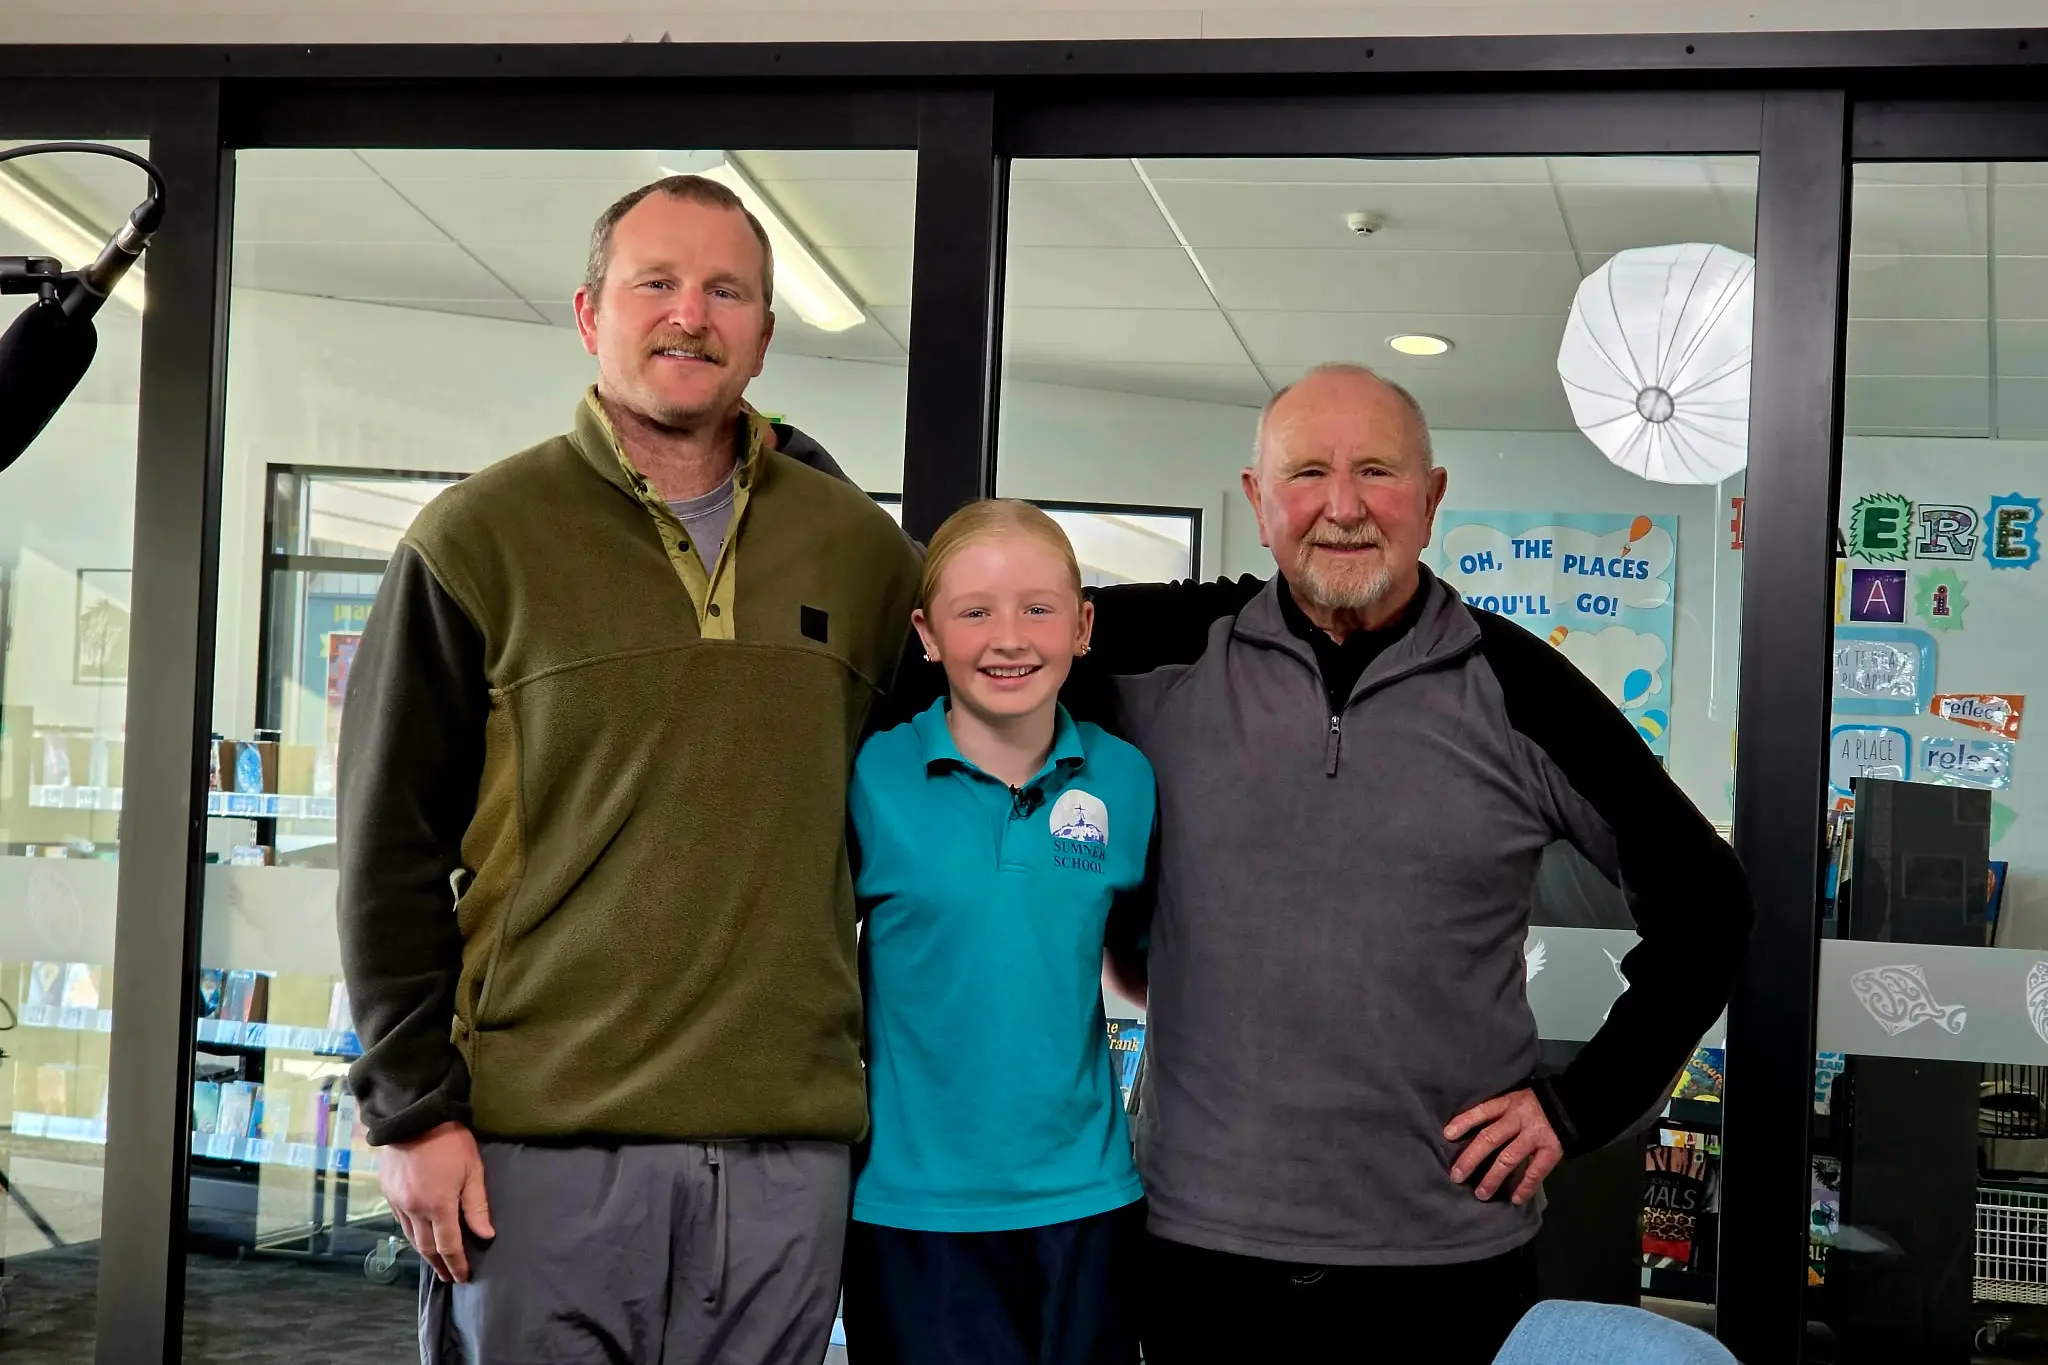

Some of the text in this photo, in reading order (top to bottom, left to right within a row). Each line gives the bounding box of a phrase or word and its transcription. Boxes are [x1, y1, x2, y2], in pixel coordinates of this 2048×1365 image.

[1460, 539, 1650, 580] OH, THE PLACES
[1466, 593, 1619, 617] YOU'LL GO!
[1841, 738, 1893, 761] A PLACE
[1053, 839, 1106, 860] SUMNER
[1053, 856, 1105, 874] SCHOOL
[1107, 1034, 1140, 1052] rank
